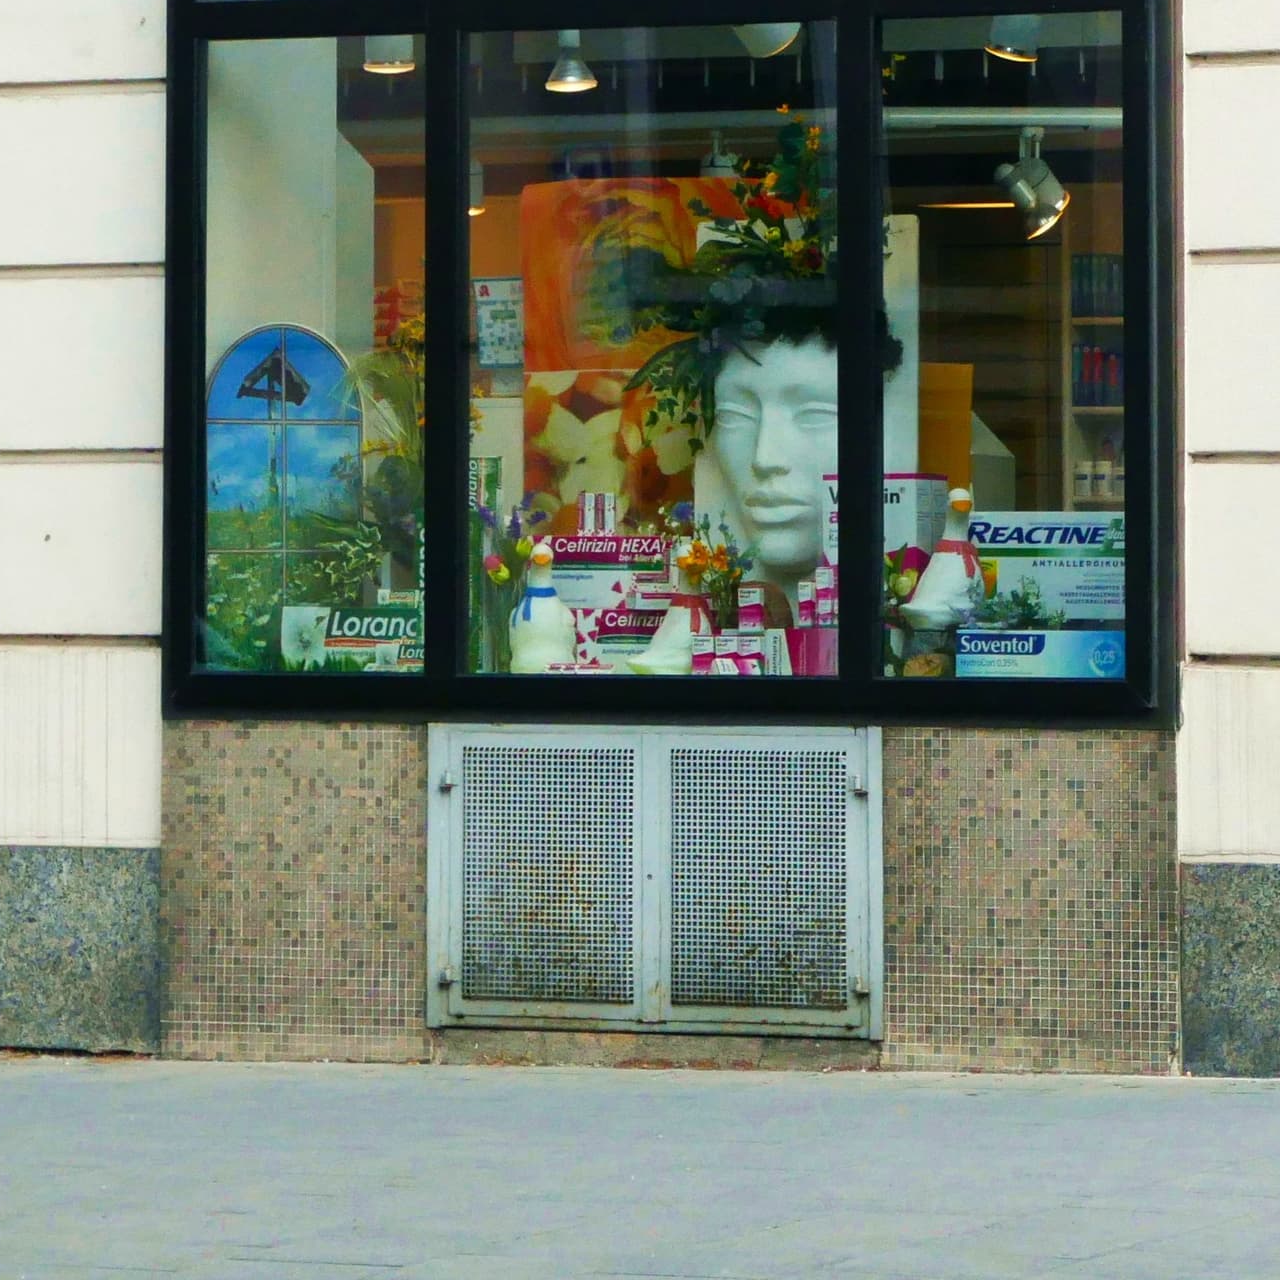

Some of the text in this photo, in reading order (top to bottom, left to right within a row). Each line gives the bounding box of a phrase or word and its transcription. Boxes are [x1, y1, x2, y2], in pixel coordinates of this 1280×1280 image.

[967, 522, 1108, 545] REACTINE
[555, 538, 617, 553] Cetirizin
[960, 635, 1034, 653] Soventol
